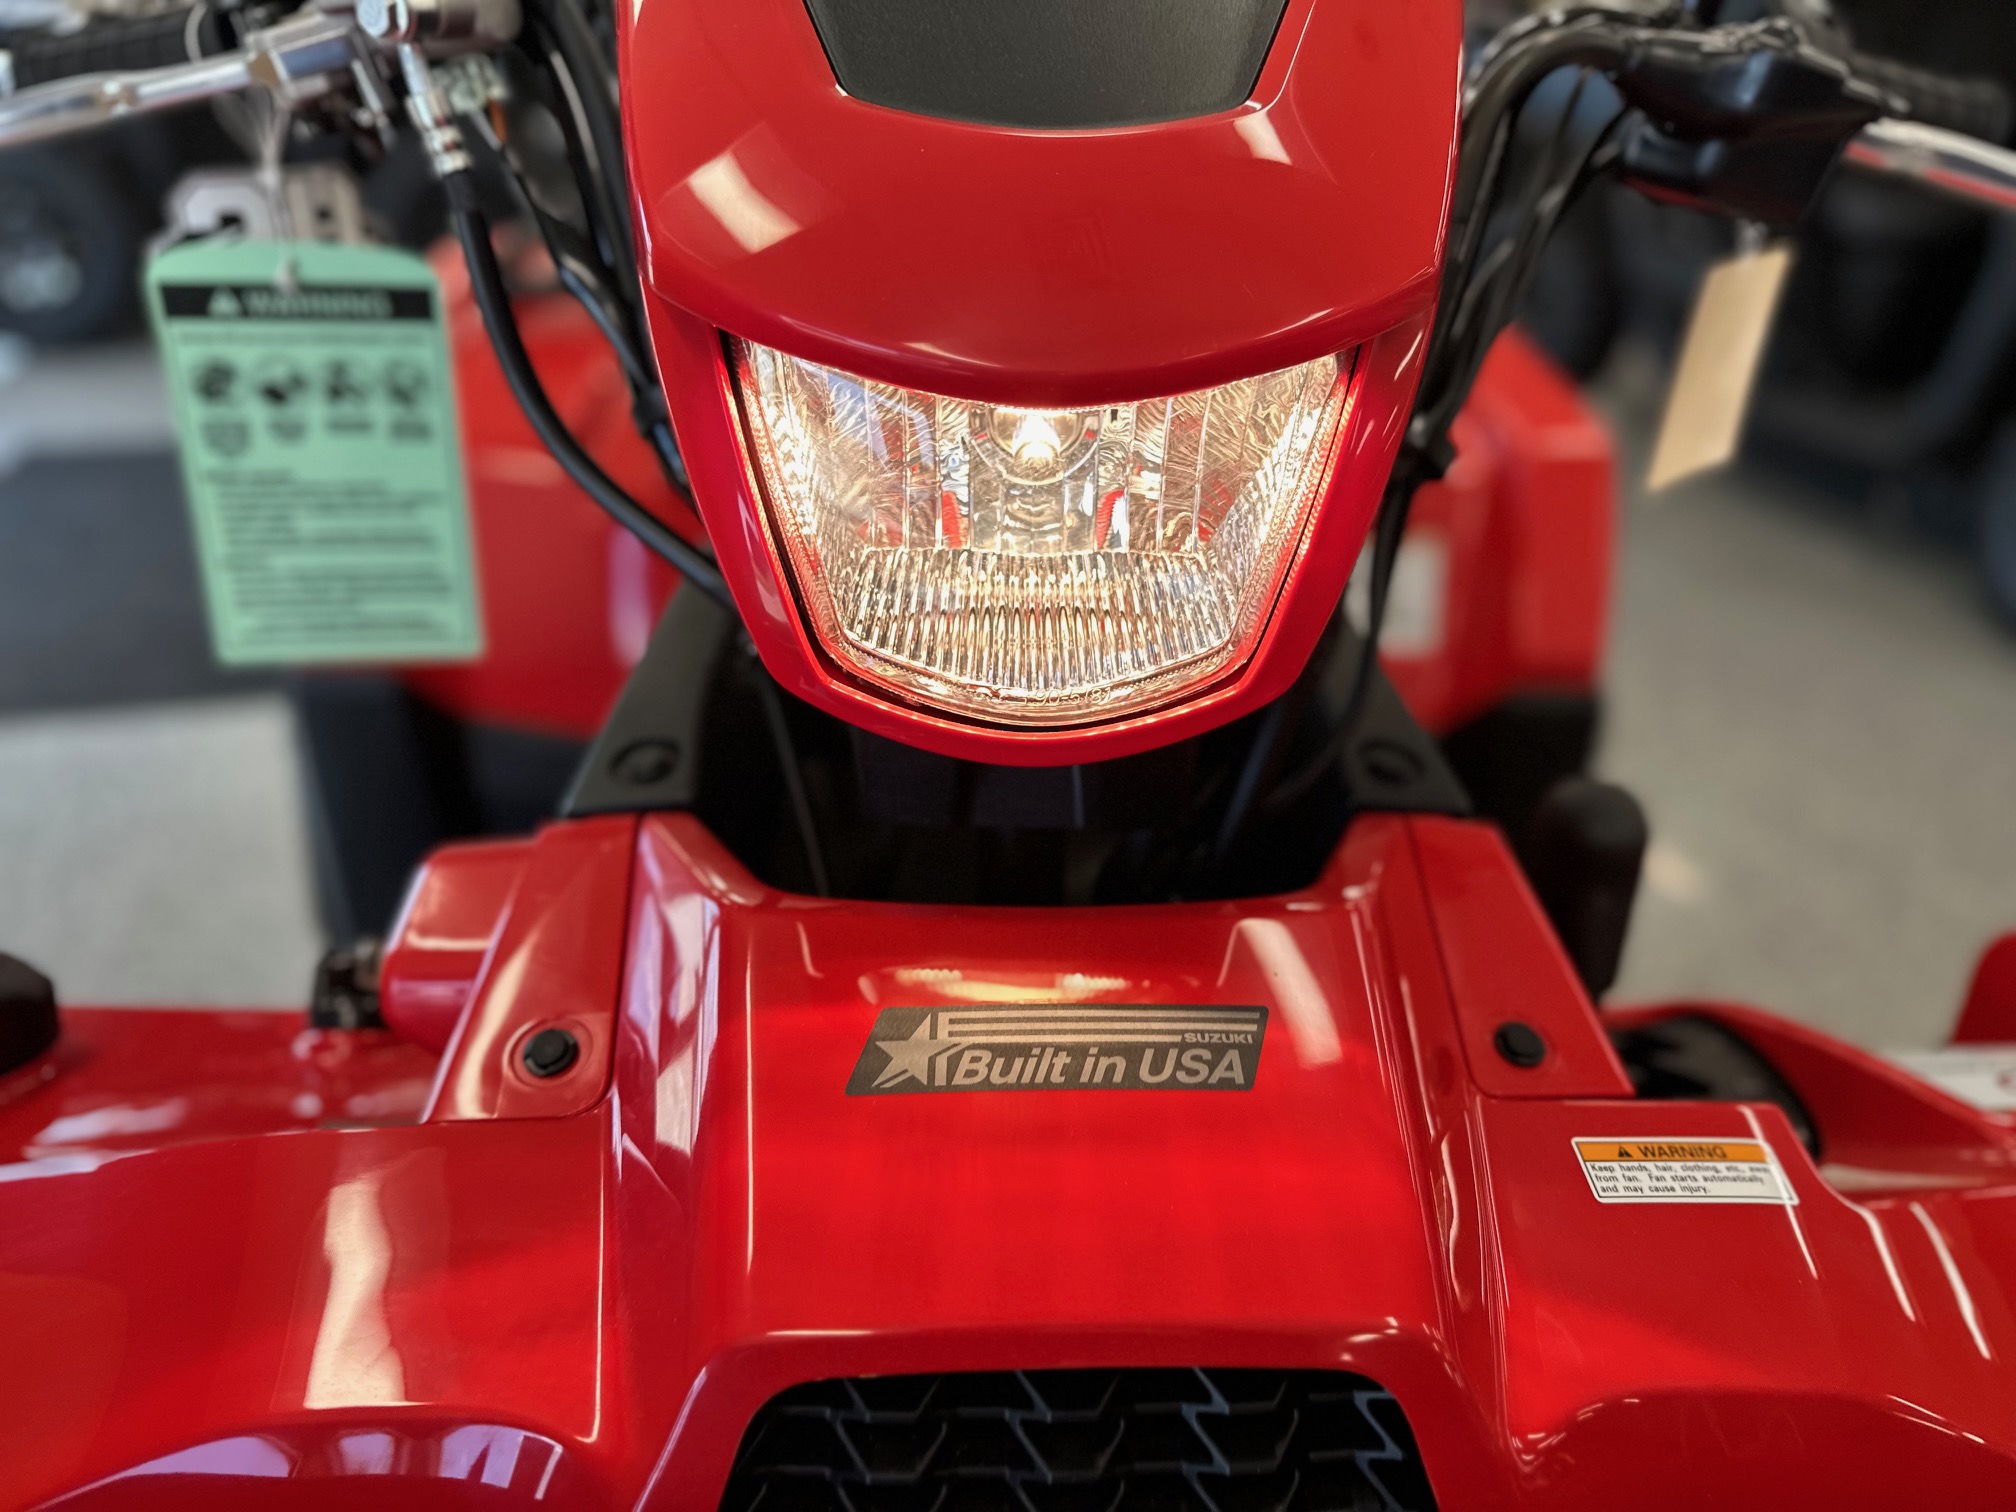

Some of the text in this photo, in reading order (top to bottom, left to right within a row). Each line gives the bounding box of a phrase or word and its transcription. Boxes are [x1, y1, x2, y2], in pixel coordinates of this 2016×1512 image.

[1184, 1032, 1253, 1044] SUZUKI
[951, 1046, 1245, 1085] Built in USA
[1637, 1144, 1727, 1158] WARNING
[1589, 1163, 1615, 1173] Keep
[1618, 1162, 1651, 1173] hands,
[1654, 1163, 1677, 1173] hair,
[1680, 1163, 1722, 1174] clothing,
[1595, 1173, 1764, 1186] from fan. Fan starts automatically
[1601, 1183, 1712, 1195] and may cause injury.
